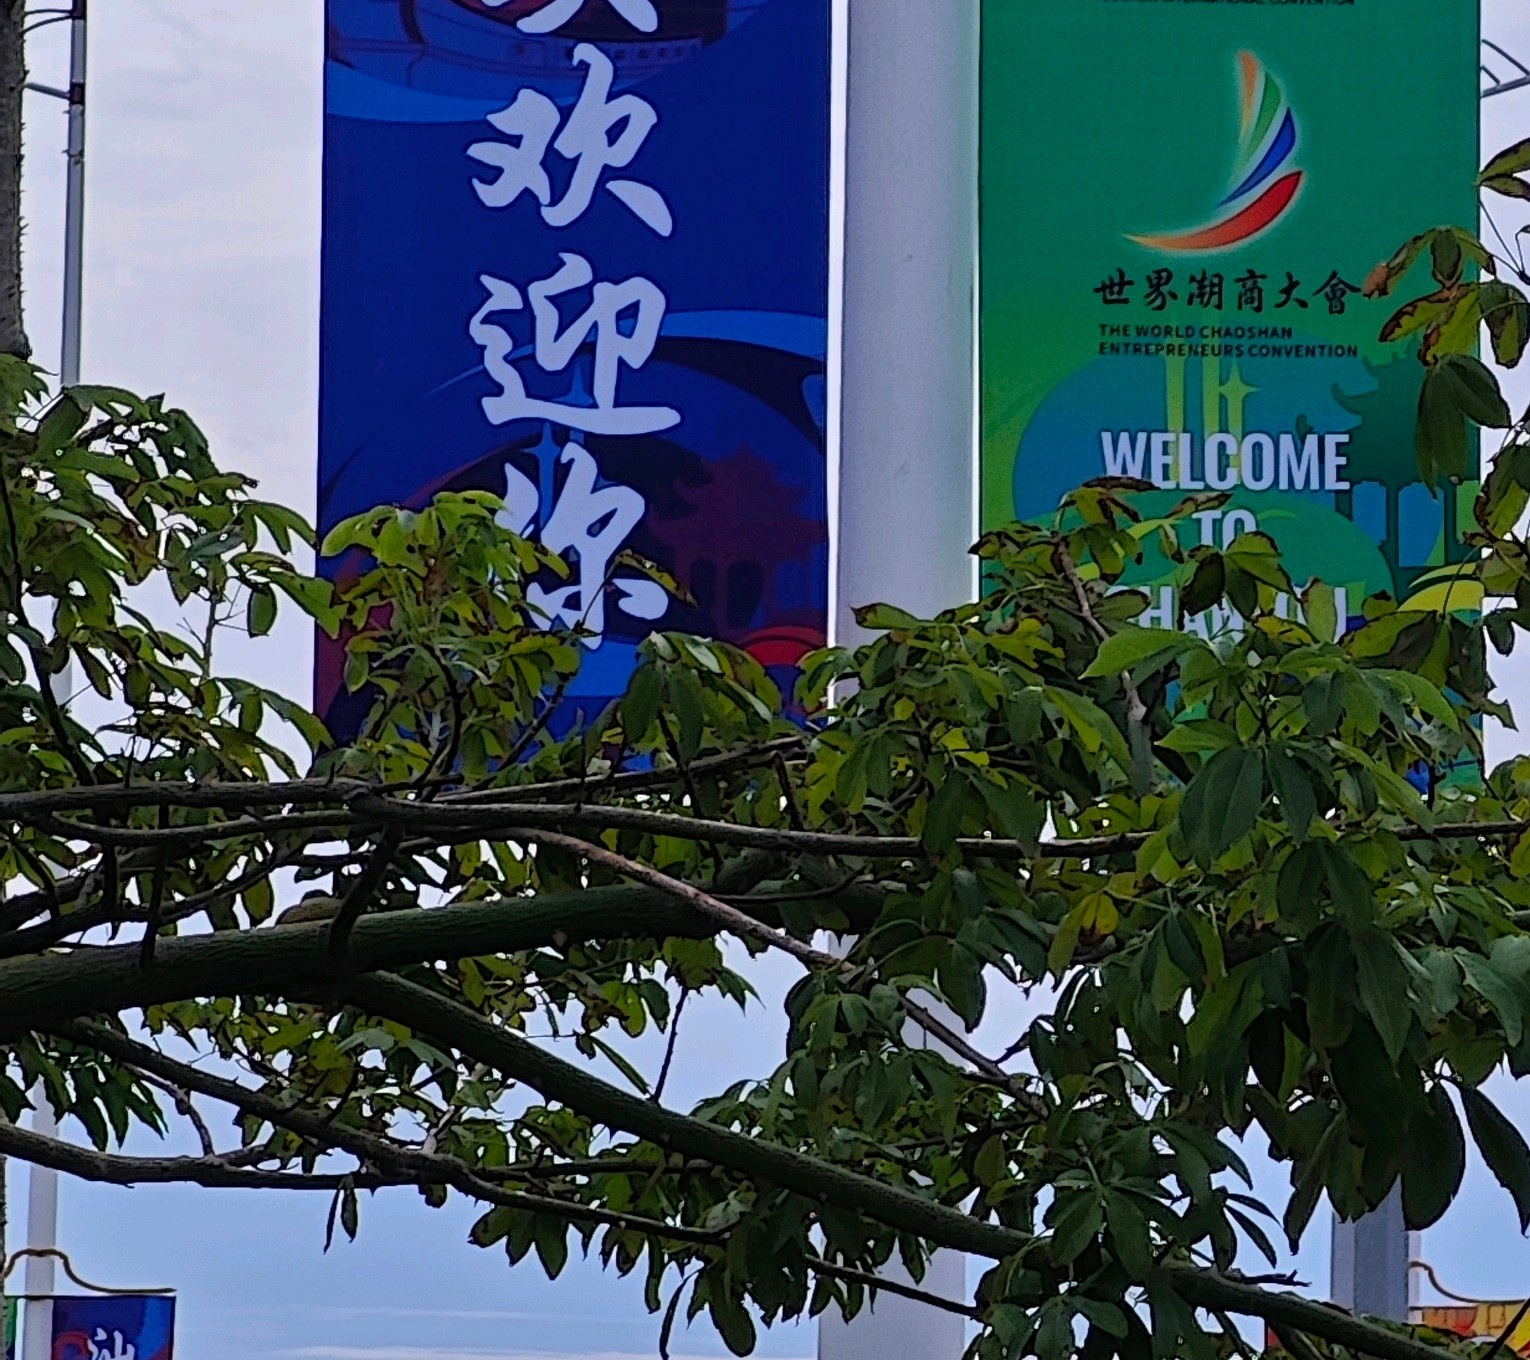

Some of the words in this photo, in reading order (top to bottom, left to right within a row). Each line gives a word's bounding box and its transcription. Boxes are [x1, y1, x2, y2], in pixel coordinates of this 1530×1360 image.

[1098, 323, 1131, 338] THE
[1134, 323, 1196, 340] WORLD
[1199, 325, 1293, 340] CHAOSHAN
[1098, 341, 1245, 358] ENTREPRENEURS
[1248, 343, 1359, 359] CONVENTION
[1101, 430, 1351, 491] WELCOME
